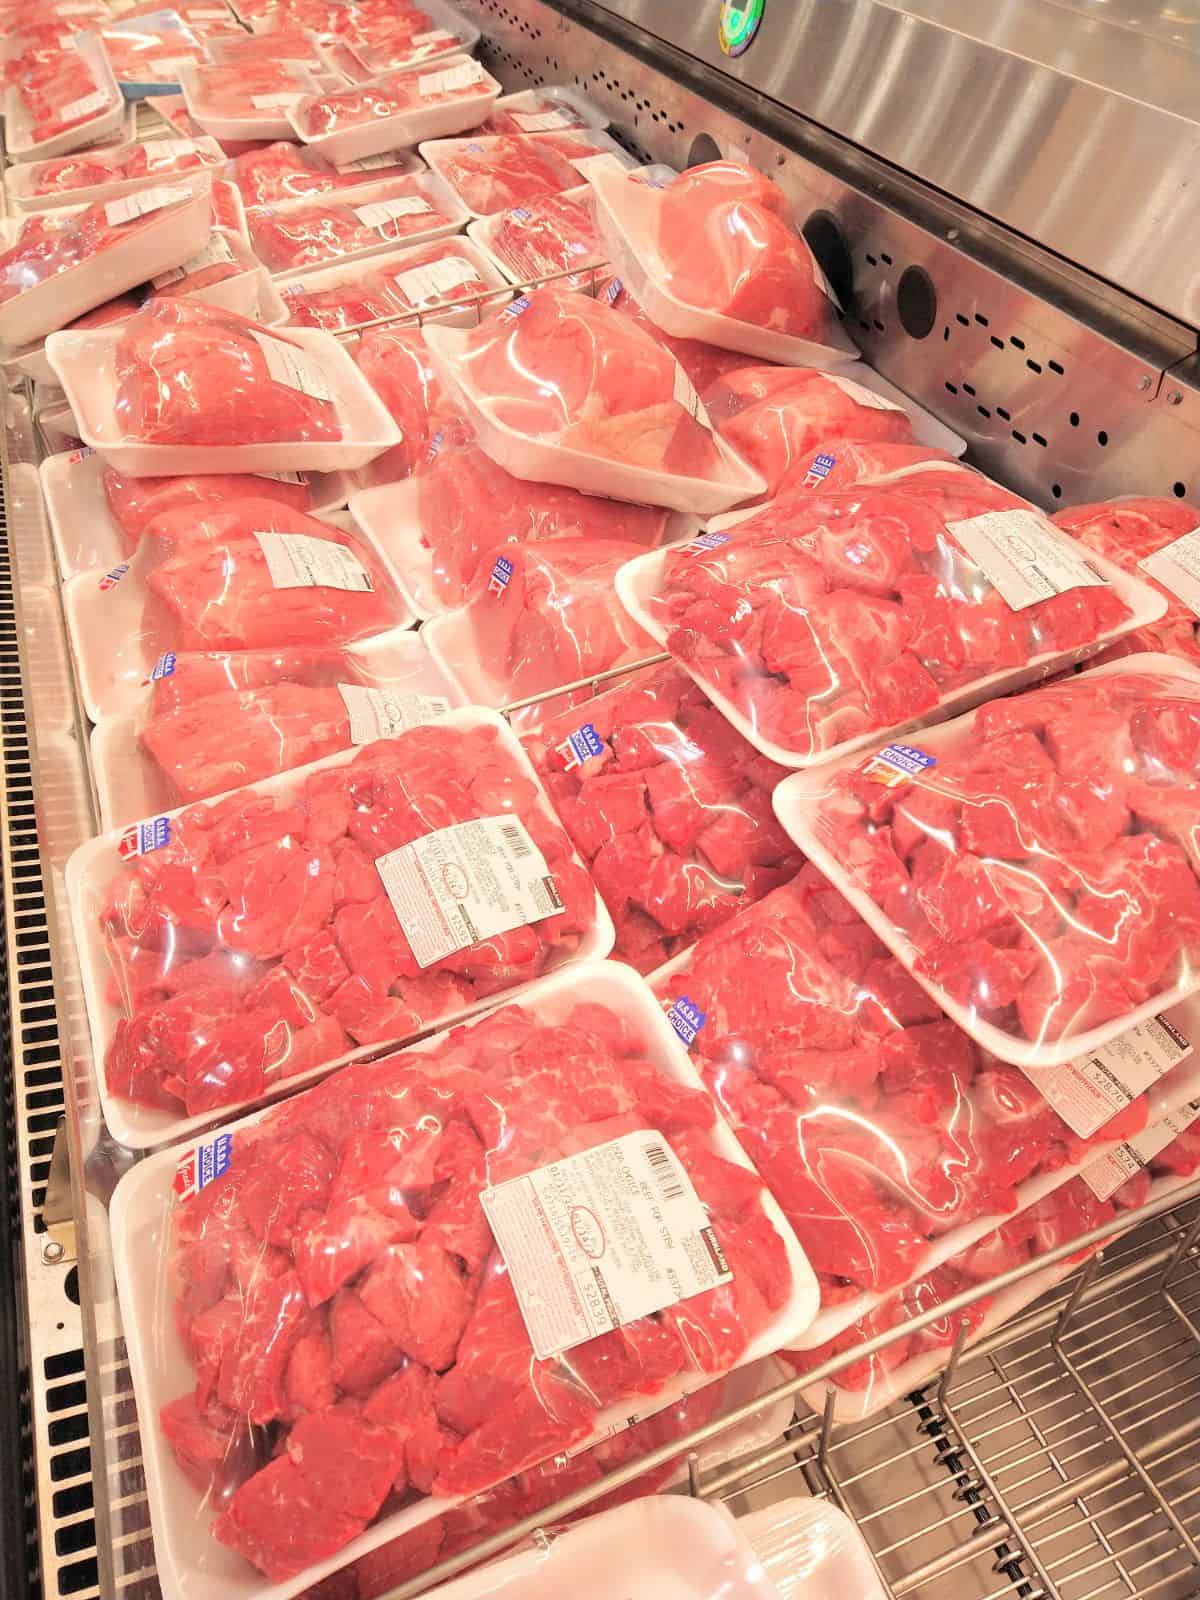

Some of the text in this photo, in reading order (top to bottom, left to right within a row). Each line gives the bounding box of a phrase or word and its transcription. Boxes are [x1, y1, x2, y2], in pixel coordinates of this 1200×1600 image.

[883, 750, 918, 769] CHOICE
[667, 1010, 693, 1040] CHOICE
[203, 1145, 213, 1182] CHOICE
